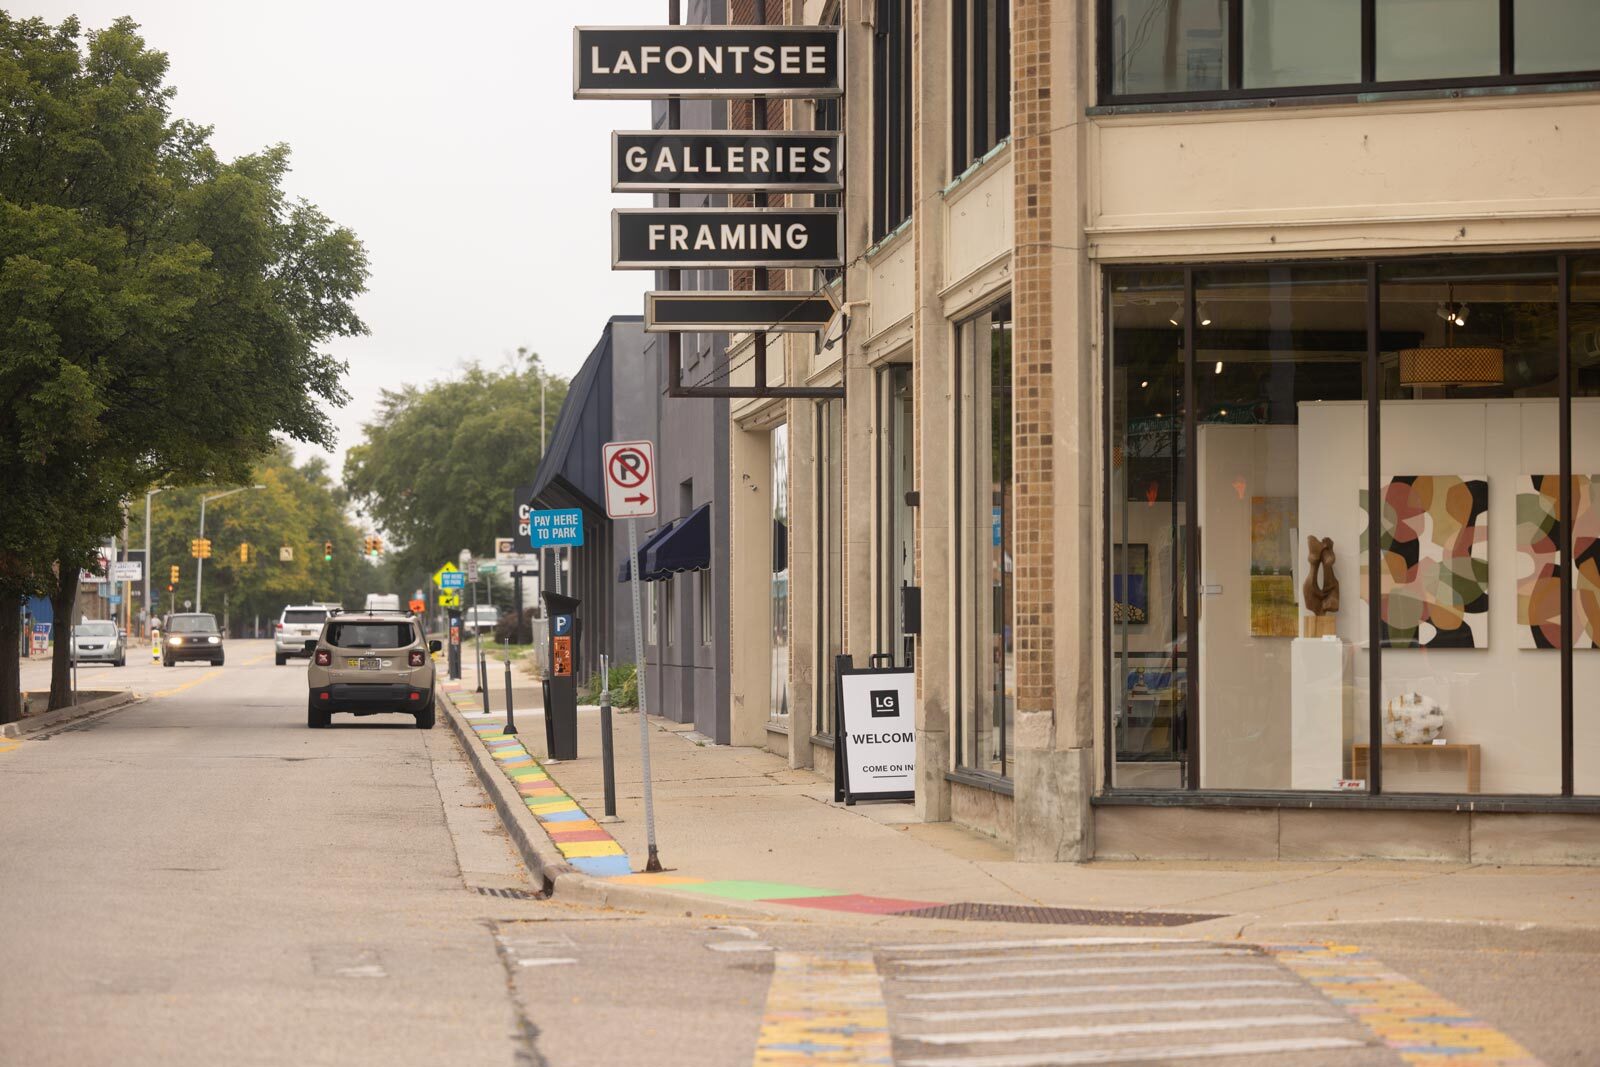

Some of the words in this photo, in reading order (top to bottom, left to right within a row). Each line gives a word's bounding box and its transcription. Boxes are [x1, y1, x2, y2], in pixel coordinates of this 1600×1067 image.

[625, 146, 831, 173] GALLERIES
[648, 223, 809, 251] FRAMING
[534, 515, 551, 527] PAY
[553, 514, 579, 526] HERE
[537, 528, 550, 540] TO
[552, 527, 577, 539] PARK
[556, 616, 567, 632] P
[876, 697, 894, 708] LG
[852, 732, 916, 745] WELCOM
[862, 765, 889, 773] COME
[889, 764, 903, 772] ON
